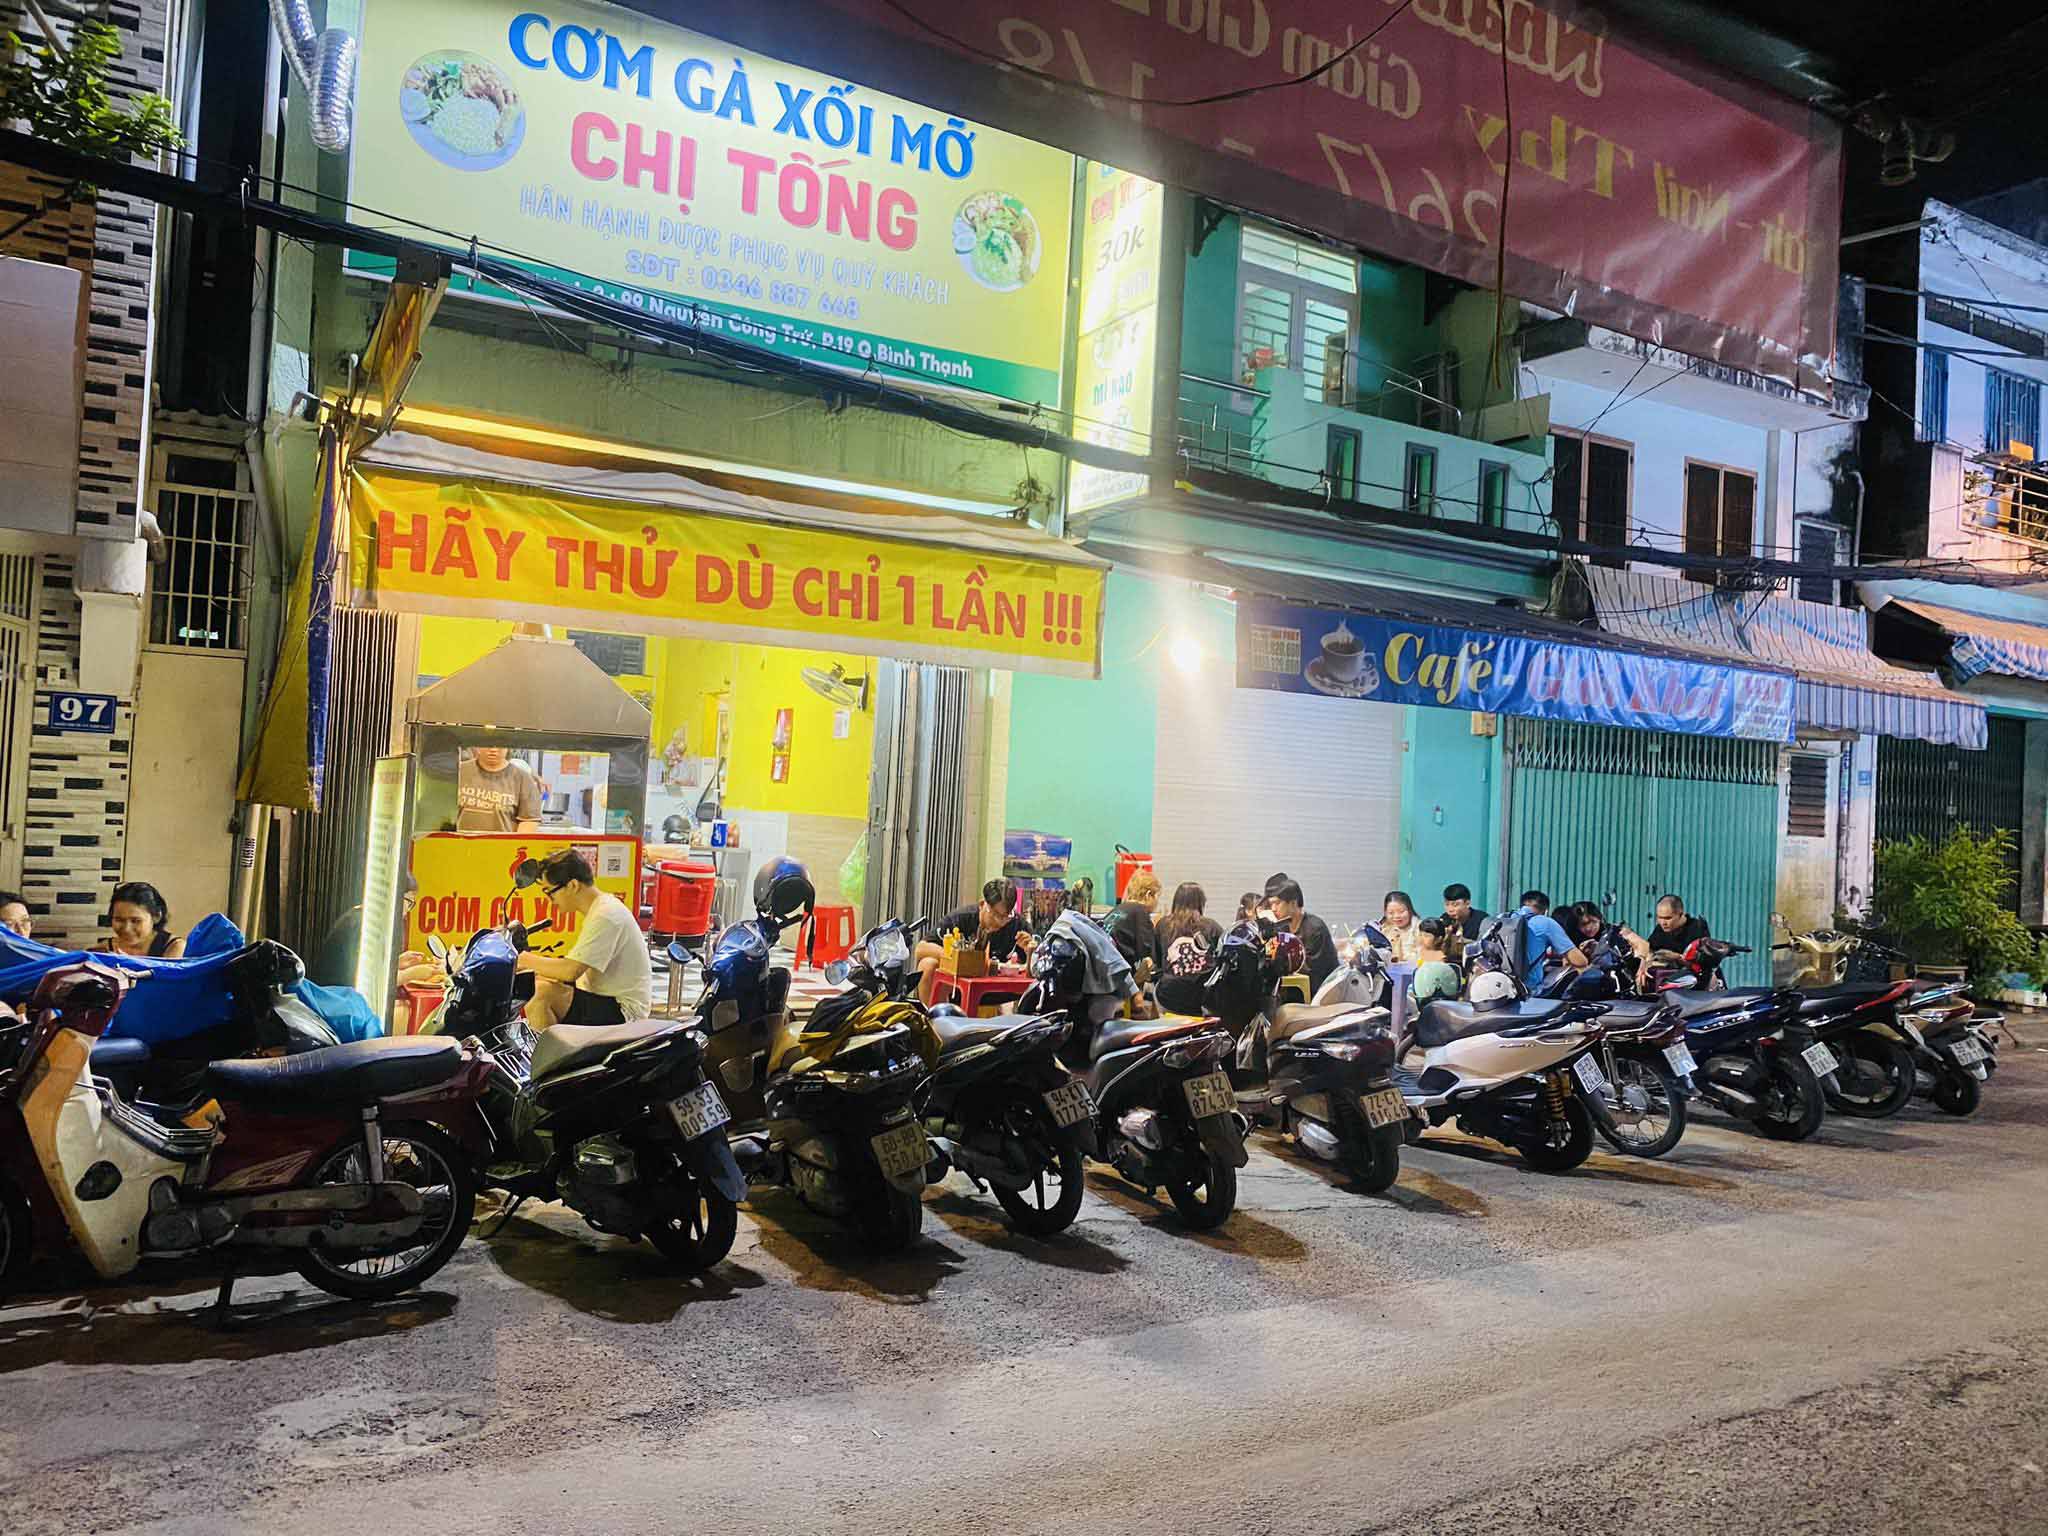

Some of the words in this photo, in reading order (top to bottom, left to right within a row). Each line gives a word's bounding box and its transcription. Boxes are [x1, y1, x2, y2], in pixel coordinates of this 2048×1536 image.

[508, 12, 657, 99] CƠM
[674, 57, 756, 127] GÀ
[773, 81, 874, 155] XỐI
[890, 114, 976, 178] MỠ
[571, 112, 697, 215] CHỊ
[727, 148, 920, 251] TỐNG
[520, 183, 572, 224] HÂN
[582, 199, 650, 241] HẠNH
[729, 233, 788, 275] PHỤC
[796, 251, 824, 284] VỤ
[832, 257, 877, 289] QUÝ
[882, 270, 950, 304] KHÁCH
[625, 249, 680, 281] SĐT
[701, 265, 763, 300] 0346
[728, 311, 777, 344] Công
[919, 351, 973, 379] Thạnh
[376, 508, 526, 582] HÃY
[546, 526, 678, 599] THỬ
[695, 543, 774, 610] DÙ
[792, 553, 881, 622] CHỈ
[895, 575, 917, 626] 1
[932, 565, 1027, 640] LẦN
[1042, 591, 1084, 646] !!!
[1384, 632, 1496, 704] Café
[59, 697, 108, 723] 97
[418, 891, 480, 934] CƠM
[675, 1087, 713, 1117] 59-S3
[681, 1103, 726, 1137] 009.59
